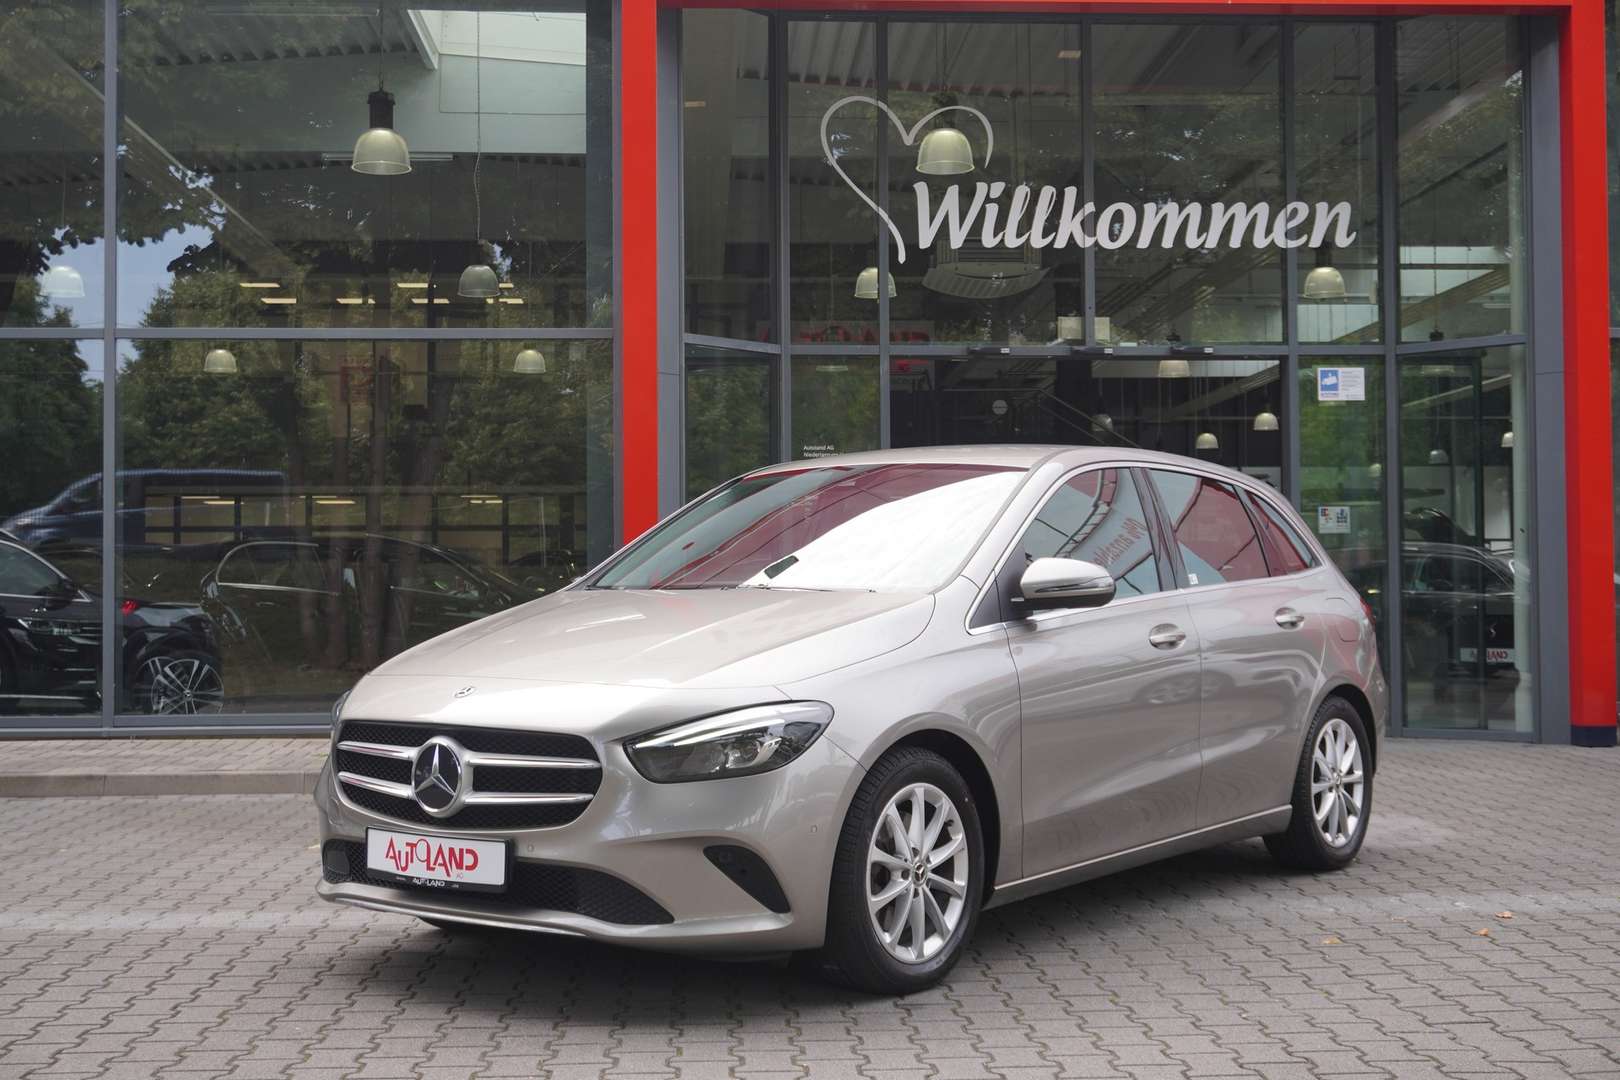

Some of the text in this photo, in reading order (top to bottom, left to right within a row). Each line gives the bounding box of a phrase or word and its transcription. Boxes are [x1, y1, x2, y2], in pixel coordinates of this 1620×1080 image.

[913, 181, 1357, 249] Willkommen
[385, 836, 479, 877] AUTOLAND
[412, 877, 446, 887] AUTLAND
